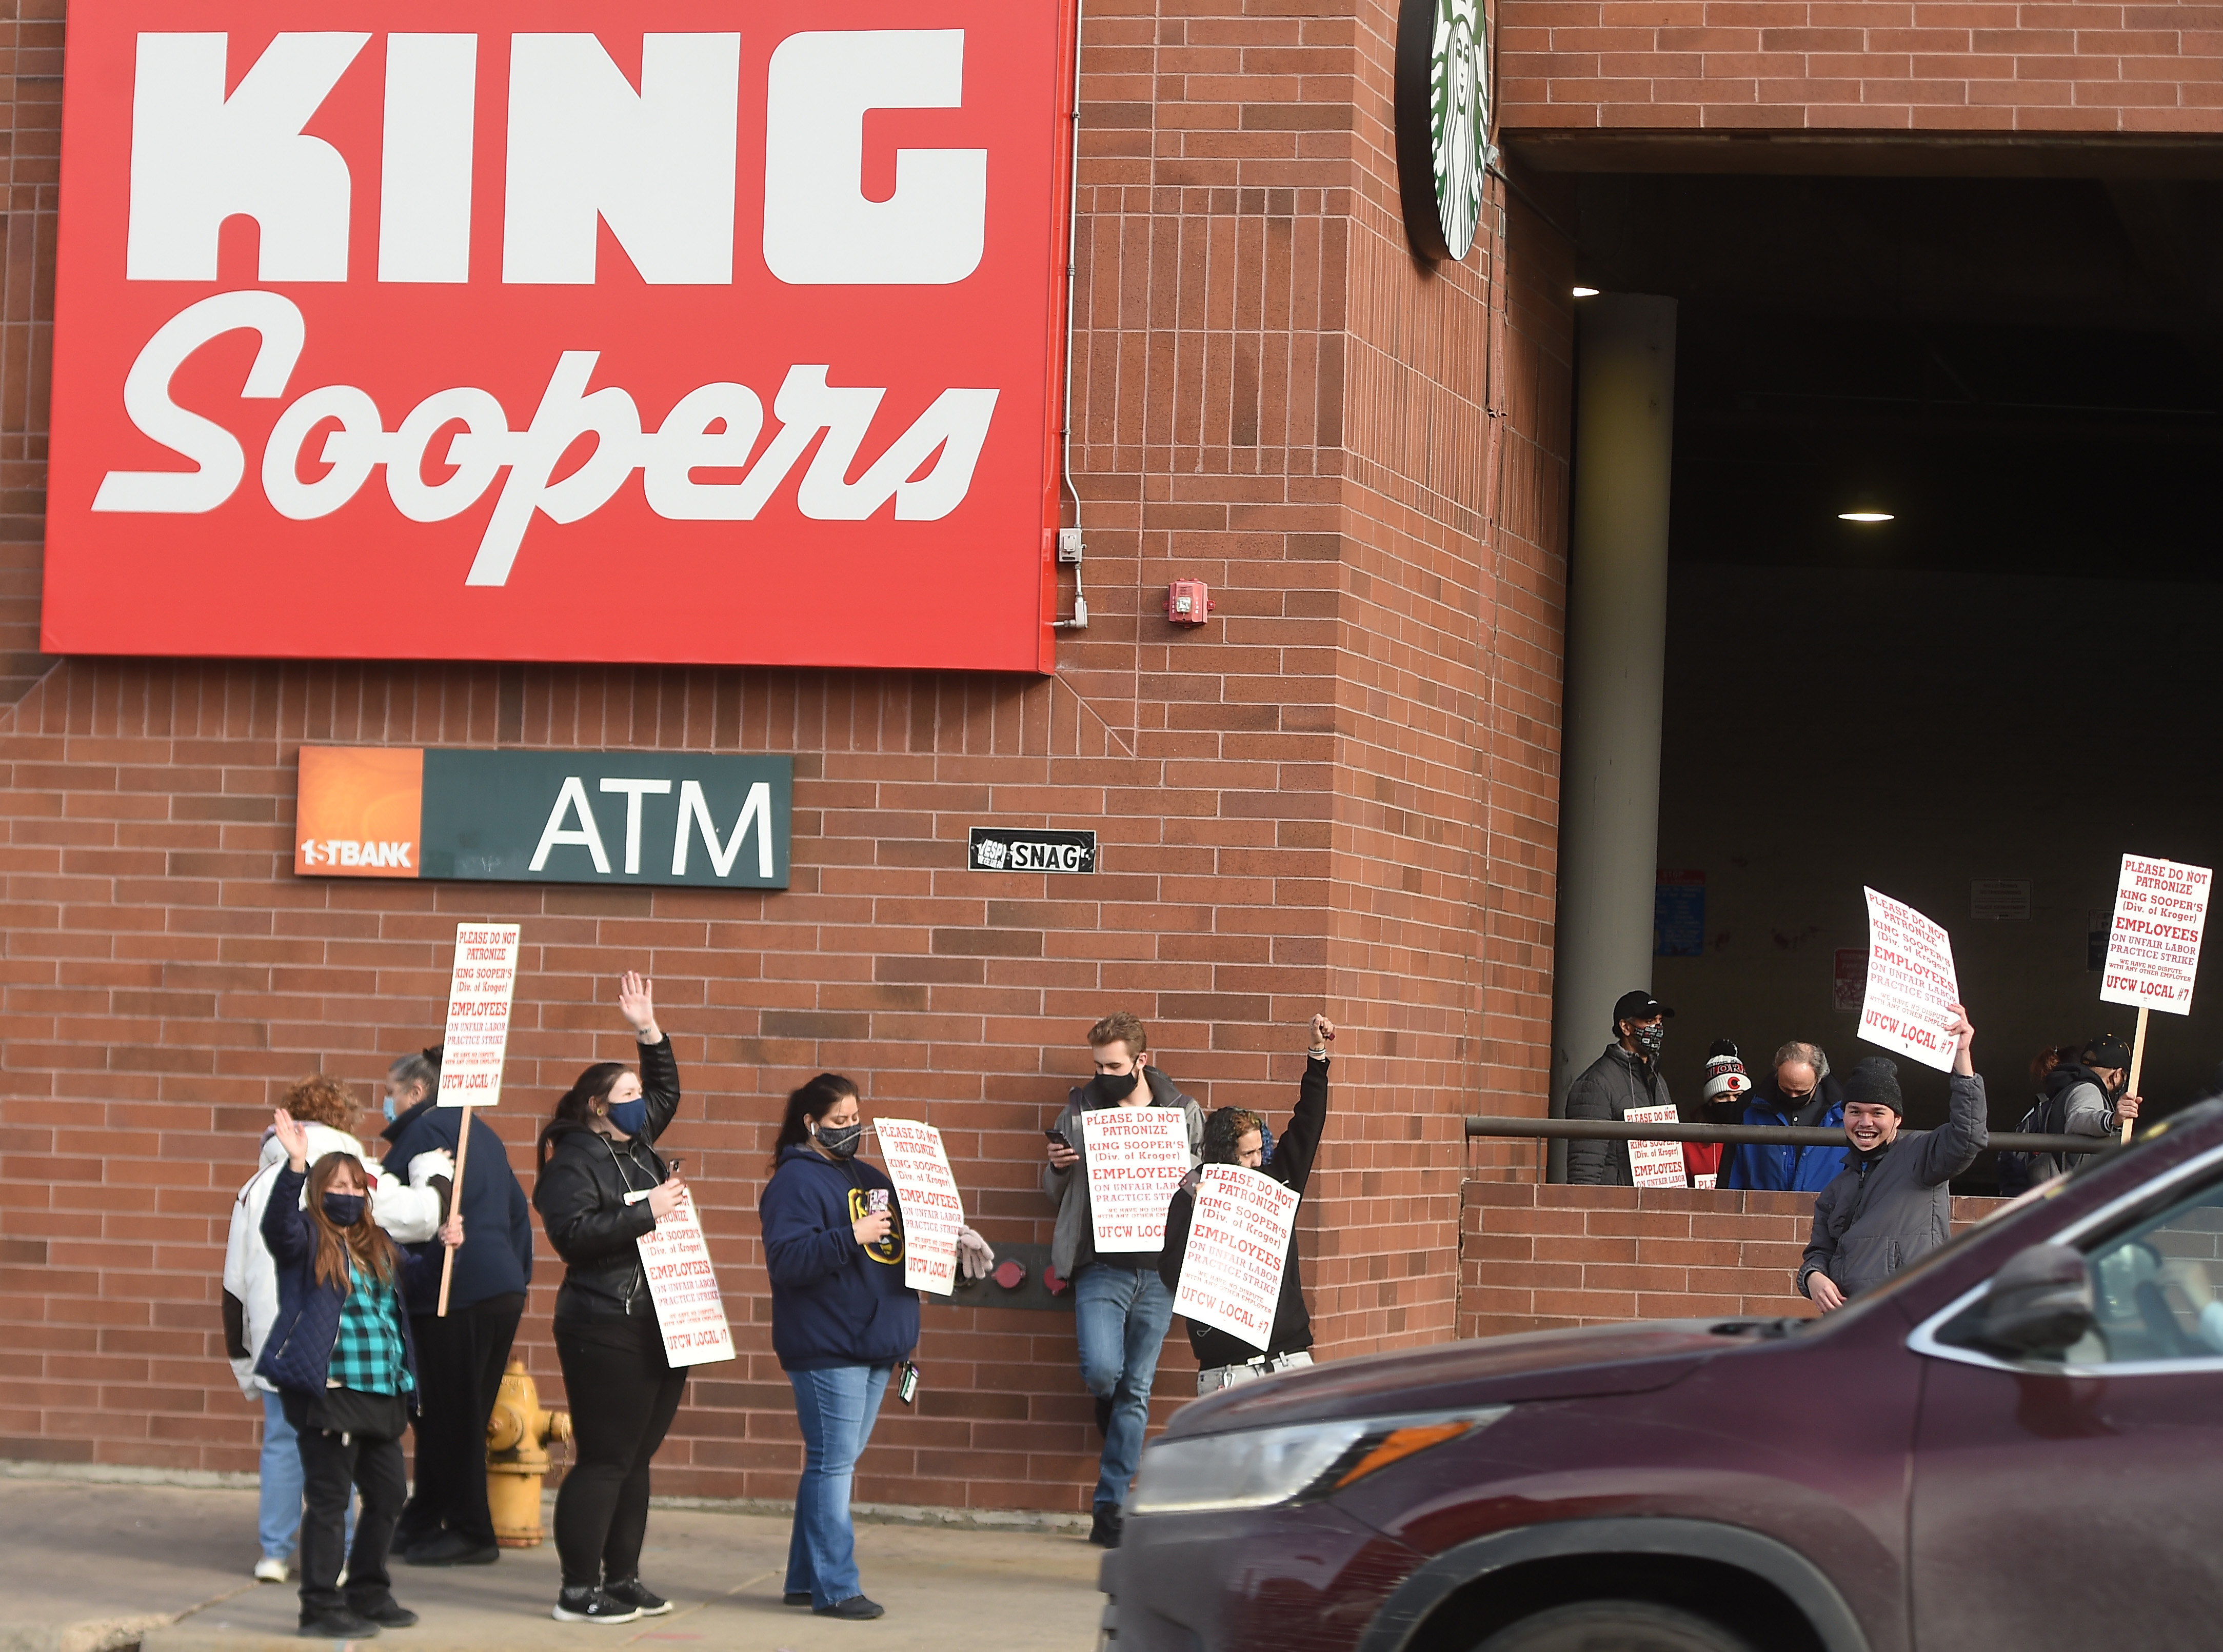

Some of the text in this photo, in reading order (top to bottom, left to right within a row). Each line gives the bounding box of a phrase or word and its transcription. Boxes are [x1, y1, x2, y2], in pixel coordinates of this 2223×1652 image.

[126, 29, 988, 285] KING
[91, 290, 1000, 586] Soopers
[528, 776, 773, 878] ATM
[301, 839, 411, 868] 1STBANK
[1015, 844, 1078, 869] SNAG
[2125, 860, 2208, 885] PLEASE DO NOT
[2135, 875, 2193, 895] PATRONIZE
[2120, 889, 2203, 912] KING SOOPER'S
[1868, 893, 1945, 943] PLEASE DO NOT
[2123, 901, 2144, 913] (Div.
[2160, 908, 2197, 924] Kroger)
[460, 931, 516, 944] PLEASE DO NOT
[1883, 910, 1937, 947] PATRONIZE
[2115, 917, 2198, 943] EMPLOYEES
[1873, 919, 1950, 968] KING SOOPER'S
[2112, 933, 2196, 956] ON UNFAIR LABOR
[467, 948, 506, 960] PATRONIZE
[1904, 943, 1912, 953] of
[1915, 949, 1949, 975] Kroger)
[2110, 944, 2194, 965] PRACTICE STRIKE
[455, 968, 512, 979] KING SOOPER'S
[1874, 945, 1955, 994] EMPLOYEES
[2139, 968, 2158, 977] OTHER
[2160, 972, 2191, 982] EMPLOYER
[2158, 965, 2182, 975] DISPUTE
[457, 982, 507, 993] (Div. of Kroger)
[1870, 973, 1922, 999] PRACTICE
[1871, 962, 1956, 1004] ON UNFAIR LABOR
[2107, 975, 2189, 1001] UFCW LOCAL #7
[451, 1002, 507, 1016] EMPLOYEES
[449, 1023, 505, 1031] ON UNFAIR LABOR
[1866, 1009, 1954, 1055] UFCW LOCAL #7
[448, 1036, 504, 1045] PRACTICE STRIKE
[443, 1074, 463, 1089] UFCW
[466, 1074, 488, 1088] LOCAL
[1728, 1077, 1740, 1089] C
[1086, 1113, 1180, 1125] PLEASE DO NOT
[1627, 1110, 1675, 1122] PLEASE DO NOT
[879, 1126, 939, 1145] PLEASE DO NOT
[1103, 1125, 1167, 1136] PATRONIZE
[895, 1142, 936, 1157] PATRONIZE
[1089, 1141, 1184, 1151] KING SOOPER'S
[1630, 1141, 1647, 1149] KING
[1634, 1151, 1649, 1160] (Div.
[1651, 1149, 1656, 1157] of
[1096, 1152, 1120, 1162] (Div.
[1139, 1152, 1180, 1161] Kroger)
[888, 1159, 949, 1176] KING SOOPER'S
[1093, 1167, 1186, 1180] EMPLOYEES
[1634, 1162, 1682, 1177] EMPLOYEES
[897, 1170, 950, 1188] (Div. of Kroger)
[1647, 1177, 1667, 1187] UNFAIR
[1669, 1175, 1685, 1183] LABOR
[1698, 1180, 1716, 1189] PLE
[900, 1188, 959, 1209] EMPLOYEES
[1097, 1193, 1151, 1202] PRACTICE
[1205, 1170, 1294, 1209] PLEASE DO NOT
[1218, 1183, 1279, 1217] PATRONIZE
[903, 1207, 961, 1223] ON UNFAIR LABOR
[1199, 1197, 1287, 1239] KING SOOPER'S
[666, 1229, 700, 1241] SOOPER'S
[906, 1220, 938, 1231] PRACTICE
[1099, 1226, 1133, 1237] UFCW
[1203, 1208, 1281, 1249] (Div. of Kroger)
[1194, 1224, 1281, 1271] EMPLOYEES
[649, 1261, 710, 1280] EMPLOYEES
[908, 1257, 947, 1278] UFCW LOCAL
[1189, 1241, 1278, 1285] ON UNFAIR LABOR
[1187, 1252, 1275, 1296] PRACTICE STRIKE
[655, 1278, 716, 1294] ON UNFAIR LABOR
[1210, 1275, 1227, 1285] HAVE
[1229, 1281, 1237, 1289] NO
[1239, 1286, 1264, 1303] DISPUTE
[659, 1291, 719, 1307] PRACTICE STRIKE
[1204, 1280, 1217, 1288] ANY
[1220, 1285, 1239, 1298] OTHER
[1241, 1295, 1271, 1314] EMPLOYER
[1182, 1286, 1269, 1335] UFCW LOCAL #7
[667, 1334, 690, 1350] UFCW
[694, 1330, 719, 1346] LOCAL
